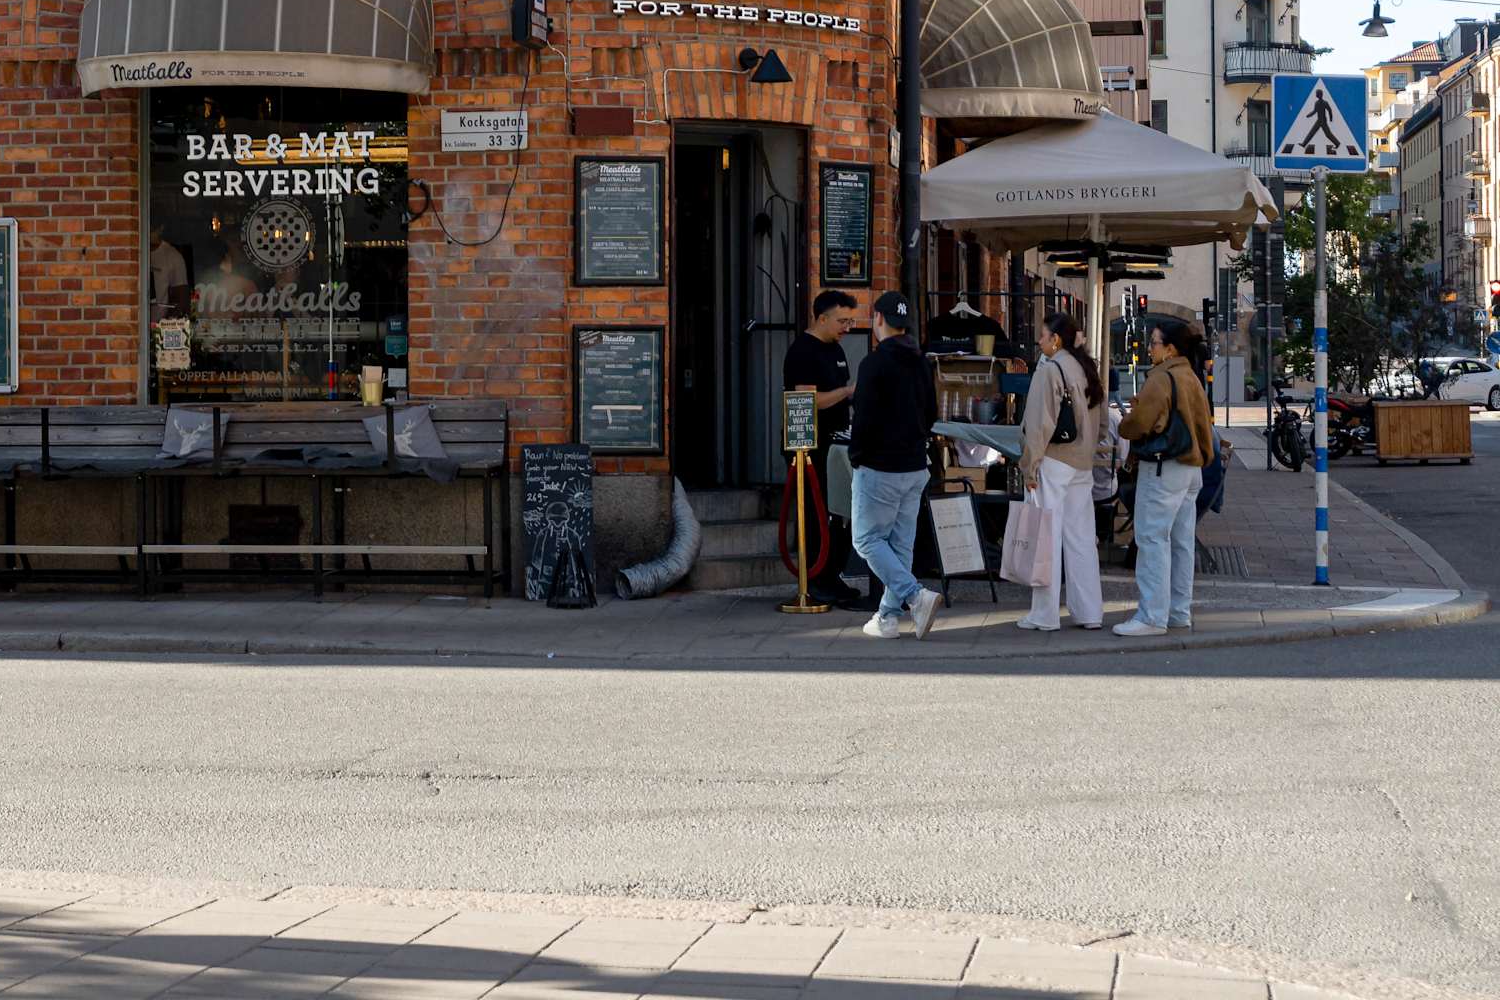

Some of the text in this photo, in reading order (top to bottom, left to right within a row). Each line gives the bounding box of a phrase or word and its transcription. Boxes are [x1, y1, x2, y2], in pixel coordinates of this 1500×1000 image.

[612, 0, 861, 32] FOR THE PEOPLE
[110, 61, 193, 82] Meatballs
[258, 70, 306, 78] PEOPLE
[460, 115, 524, 130] Kocksgatan
[187, 131, 375, 160] BAR & MAT
[183, 167, 380, 197] SERVERING
[996, 186, 1156, 203] GOTLANDS BRYGGERI
[194, 281, 361, 312] Meatballs
[219, 370, 247, 382] ALLA
